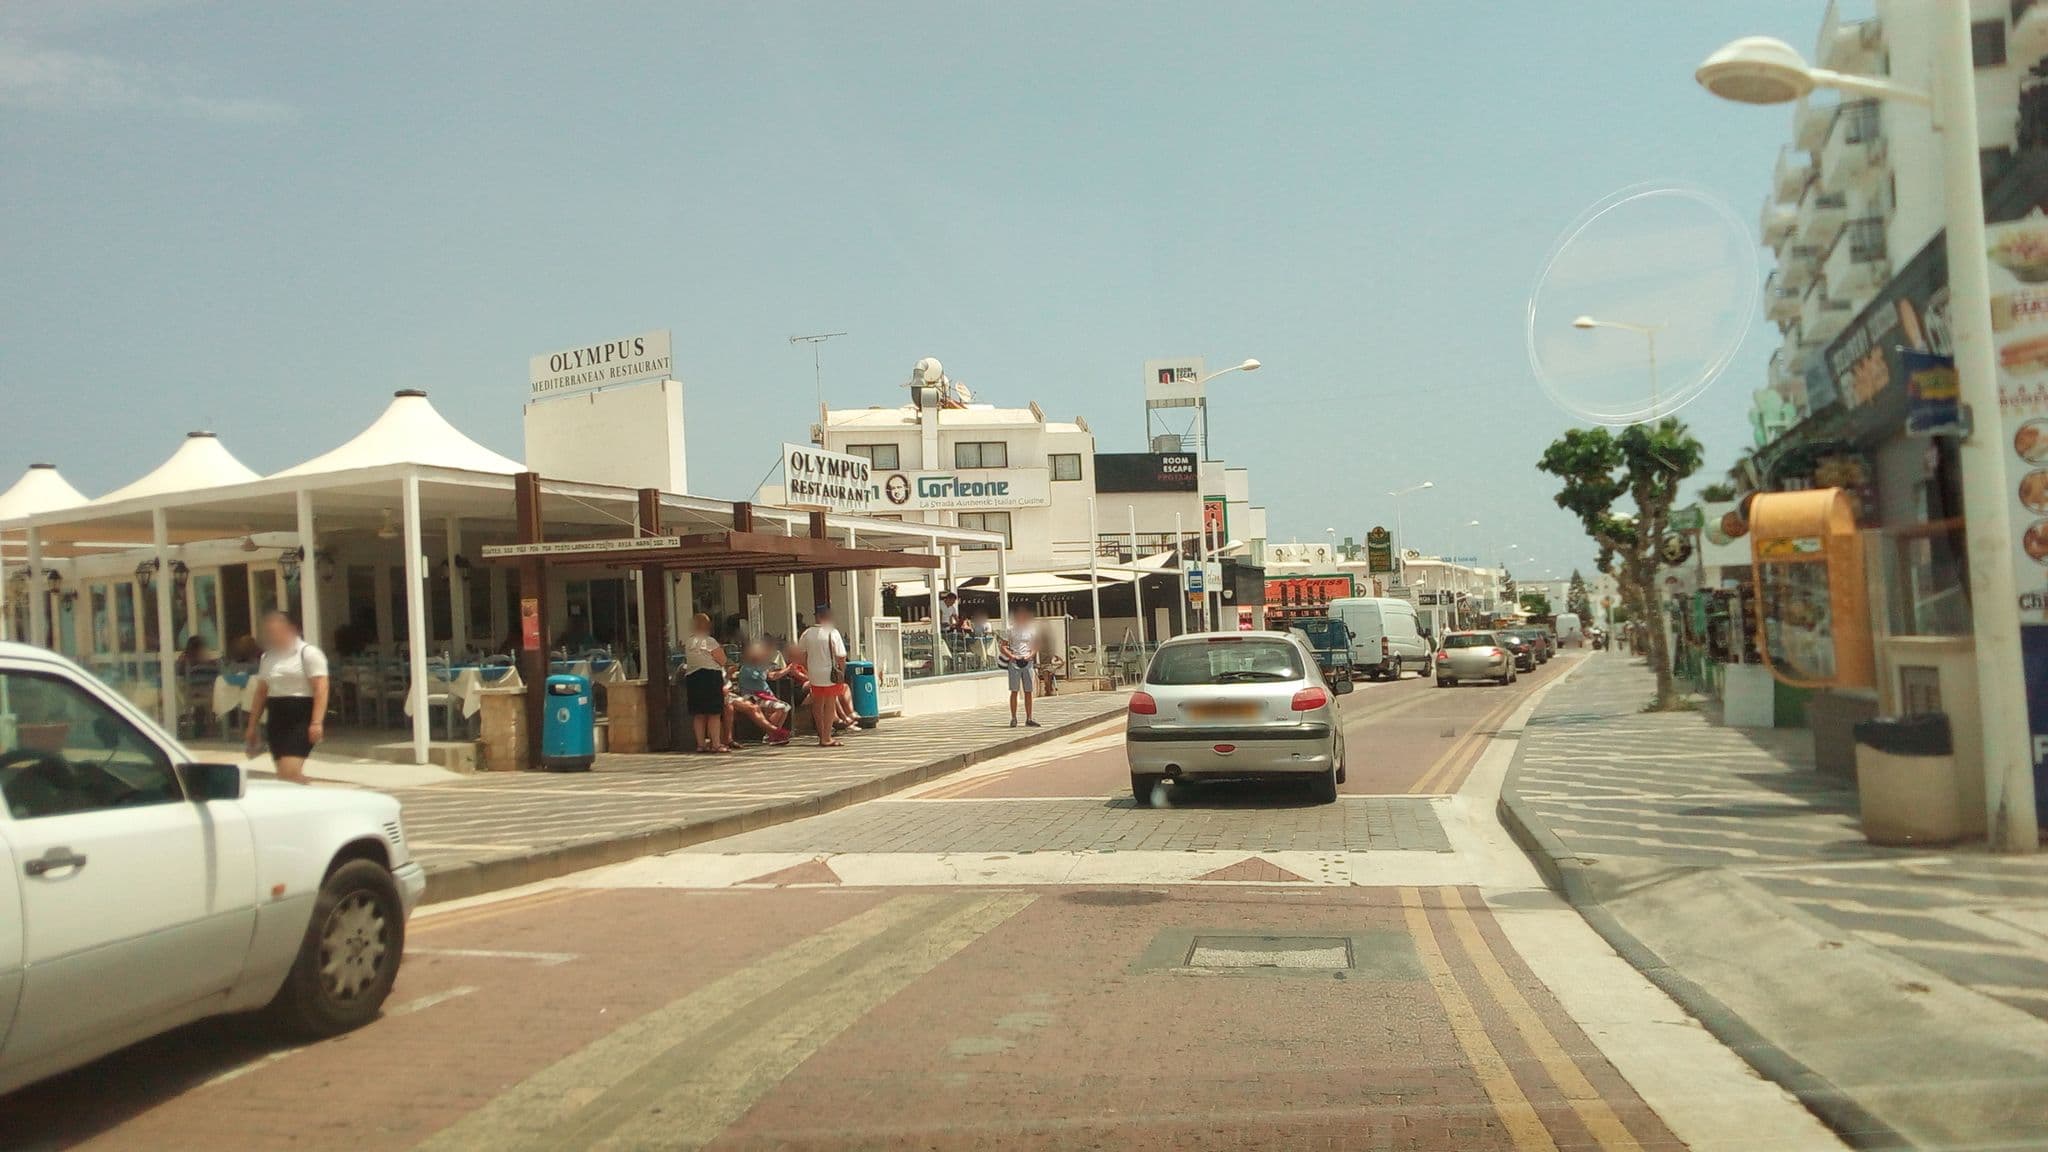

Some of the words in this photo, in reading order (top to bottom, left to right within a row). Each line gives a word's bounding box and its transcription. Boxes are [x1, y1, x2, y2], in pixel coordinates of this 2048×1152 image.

[550, 337, 644, 373] OLYMPUS
[531, 370, 605, 392] MEDITERRANEAN
[610, 357, 669, 378] RESTAURANT
[791, 451, 868, 482] OLYMPUS
[1162, 456, 1189, 465] ROOM
[1163, 465, 1193, 473] ESCAPE
[791, 478, 871, 503] RESTAURANT
[918, 476, 1009, 498] Corleone
[930, 499, 954, 509] Strada
[956, 497, 993, 507] Authentic
[994, 497, 1017, 507] Italian
[1019, 496, 1045, 505] Cuisine
